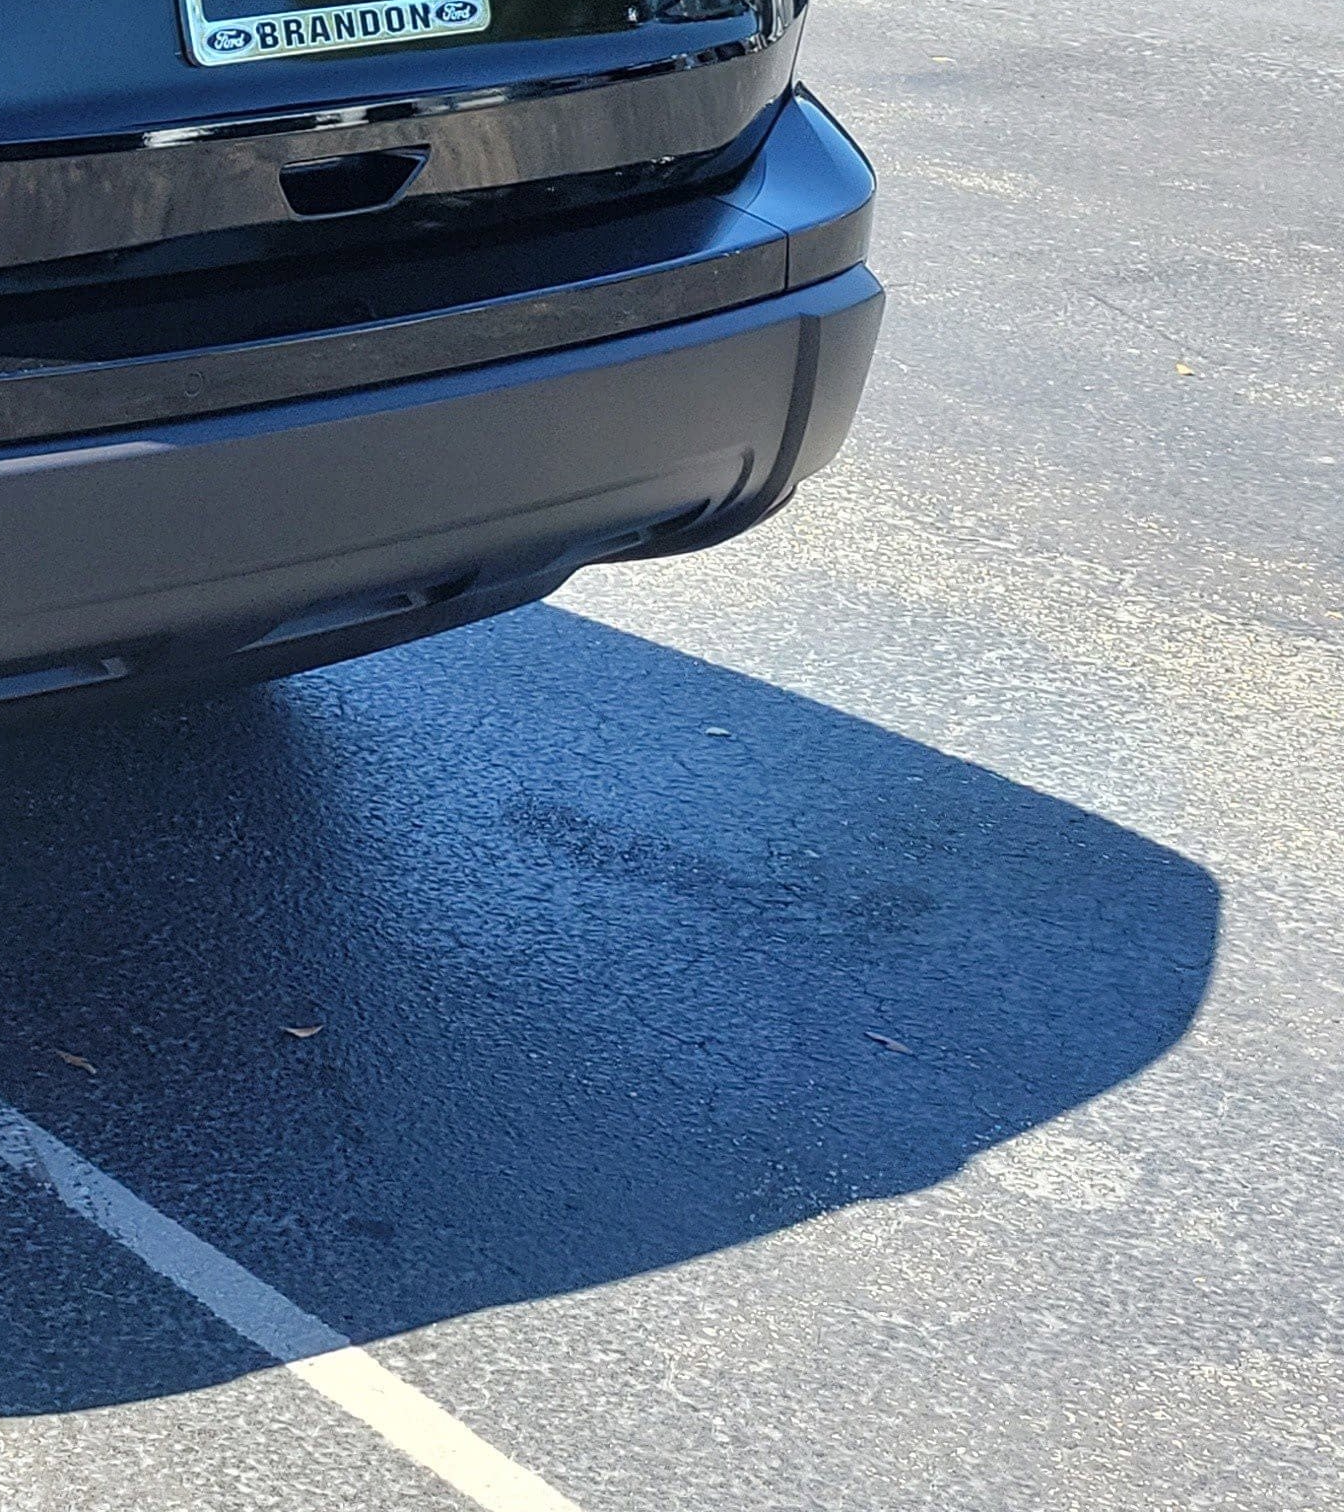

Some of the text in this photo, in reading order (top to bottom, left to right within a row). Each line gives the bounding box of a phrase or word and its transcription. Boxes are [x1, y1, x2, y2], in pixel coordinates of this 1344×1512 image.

[212, 2, 474, 51] Ford BRANDON Ford
